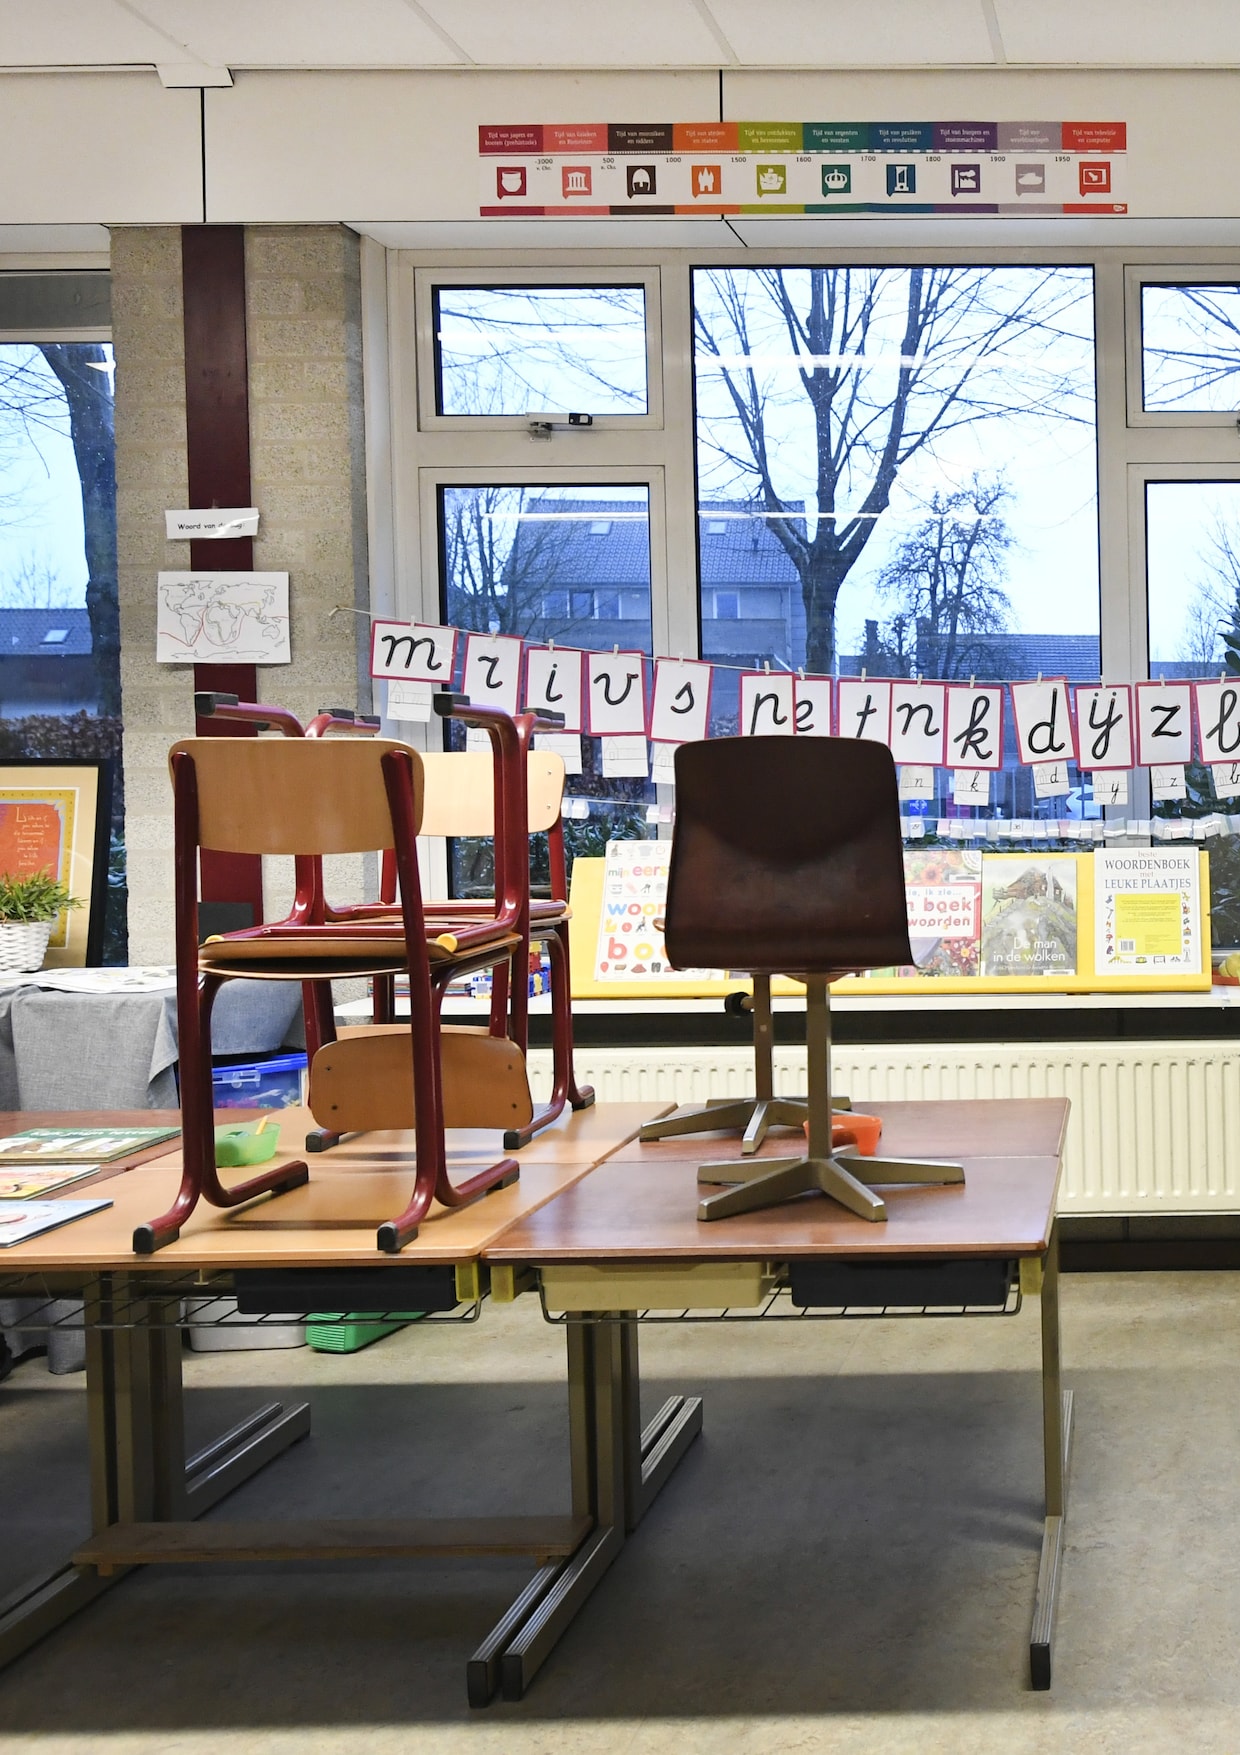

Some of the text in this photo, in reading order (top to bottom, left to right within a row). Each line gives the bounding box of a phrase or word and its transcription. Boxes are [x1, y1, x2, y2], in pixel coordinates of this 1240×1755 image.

[382, 635, 442, 671] m
[545, 663, 563, 703] i
[593, 672, 639, 705] v
[670, 681, 695, 714] s
[795, 699, 815, 733] e
[897, 702, 939, 737] n
[1027, 688, 1066, 754] d
[1150, 705, 1182, 737] z
[953, 695, 993, 760] k
[971, 771, 979, 791] k
[1050, 766, 1059, 783] d
[1170, 778, 1178, 787] z
[1230, 763, 1240, 784] b
[1104, 858, 1191, 871] WOORDENBOEK
[1105, 876, 1191, 890] LEUKE PLAATJES
[923, 897, 972, 913] boek
[907, 915, 971, 928] woorden
[1014, 937, 1057, 950] De man
[993, 950, 1066, 962] in de wolken
